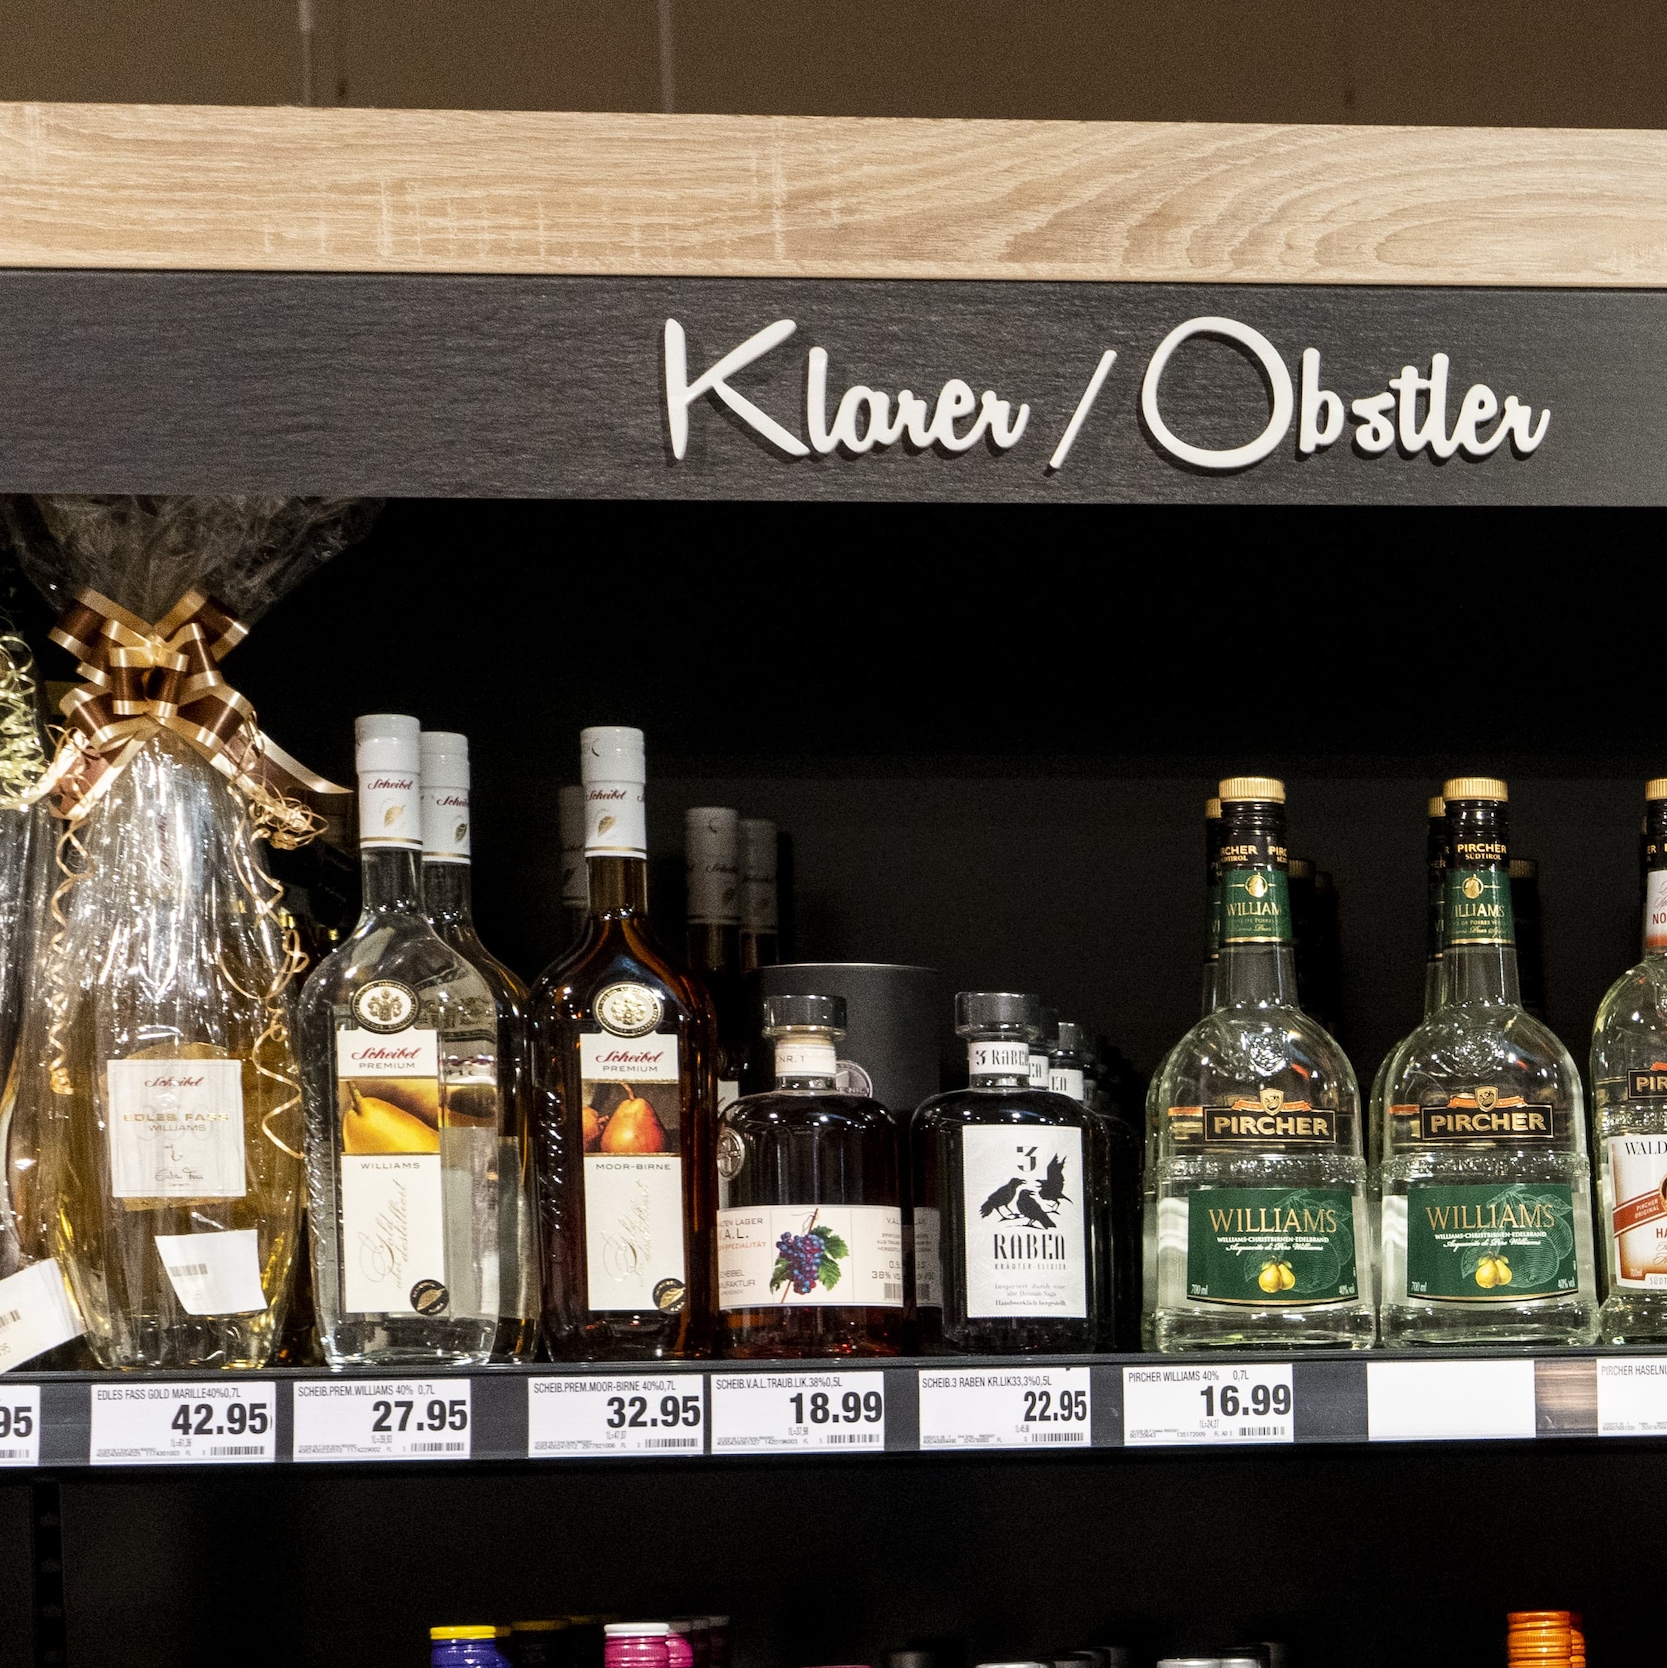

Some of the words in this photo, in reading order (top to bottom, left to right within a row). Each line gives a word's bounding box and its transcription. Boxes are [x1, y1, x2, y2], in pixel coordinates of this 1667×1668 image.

[665, 318, 1030, 460] Klarer
[1142, 317, 1551, 468] Obstler
[352, 1047, 422, 1062] Scheibel
[359, 1062, 416, 1070] PREMIUM
[1214, 1116, 1328, 1136] PIRCHER
[1626, 1141, 1667, 1155] WALD
[361, 1162, 420, 1170] WILLIAMS
[596, 1163, 671, 1171] MOOR-BIRNE
[1209, 1208, 1337, 1234] WILLIAMS
[993, 1233, 1065, 1261] RABEN
[1128, 1372, 1161, 1382] PIRCHER
[1163, 1371, 1200, 1381] WILLIAMS
[1202, 1371, 1219, 1380] 40%
[607, 1396, 700, 1429] 32.95
[790, 1392, 882, 1424] 18.99
[1024, 1391, 1087, 1423] 22.95
[1200, 1384, 1291, 1416] 16.99
[171, 1403, 268, 1435] 42.95
[372, 1400, 468, 1432] 27.95
